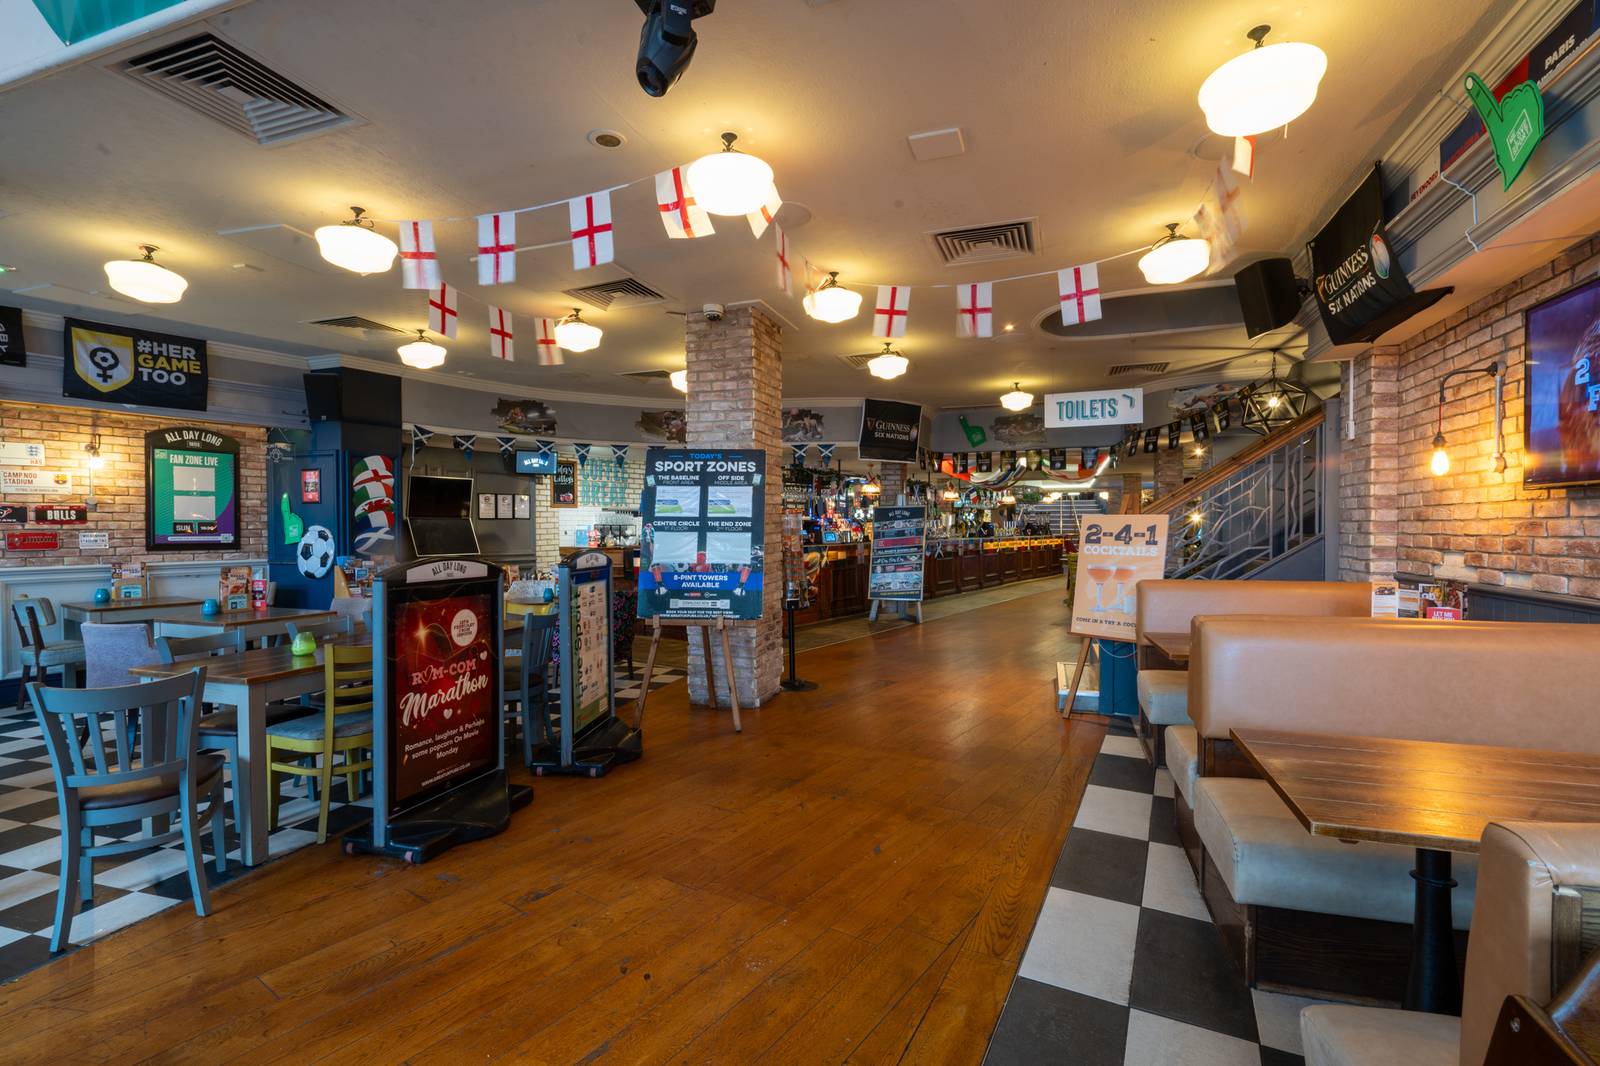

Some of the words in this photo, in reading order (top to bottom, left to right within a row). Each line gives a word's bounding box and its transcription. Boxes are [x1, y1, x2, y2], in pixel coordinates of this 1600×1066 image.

[1544, 34, 1575, 70] PARIS
[1324, 245, 1369, 294] GUINNESS
[1328, 299, 1344, 315] SIX
[1344, 272, 1377, 307] NATIONS
[137, 339, 196, 360] #HER
[138, 355, 201, 374] GAME
[138, 367, 187, 386] TOO
[1056, 398, 1118, 421] TOILETS
[875, 420, 911, 433] GUINNESS
[165, 431, 182, 443] ALL
[182, 430, 200, 440] DAY
[201, 432, 223, 447] LONG
[886, 432, 909, 441] NATIONS
[169, 454, 184, 464] FAN
[185, 455, 203, 465] ZONE
[204, 456, 218, 466] LIVE
[654, 461, 704, 473] SPORT
[706, 461, 757, 473] ZONES
[46, 510, 76, 520] BULLS
[1085, 523, 1158, 545] 2-4-1
[1083, 545, 1159, 557] COCKTAILS
[431, 566, 442, 576] ALL
[442, 562, 454, 571] DAY
[454, 562, 467, 574] LONG
[400, 671, 488, 726] Marathon
[429, 740, 454, 755] popcorn
[436, 746, 459, 759] Monday
